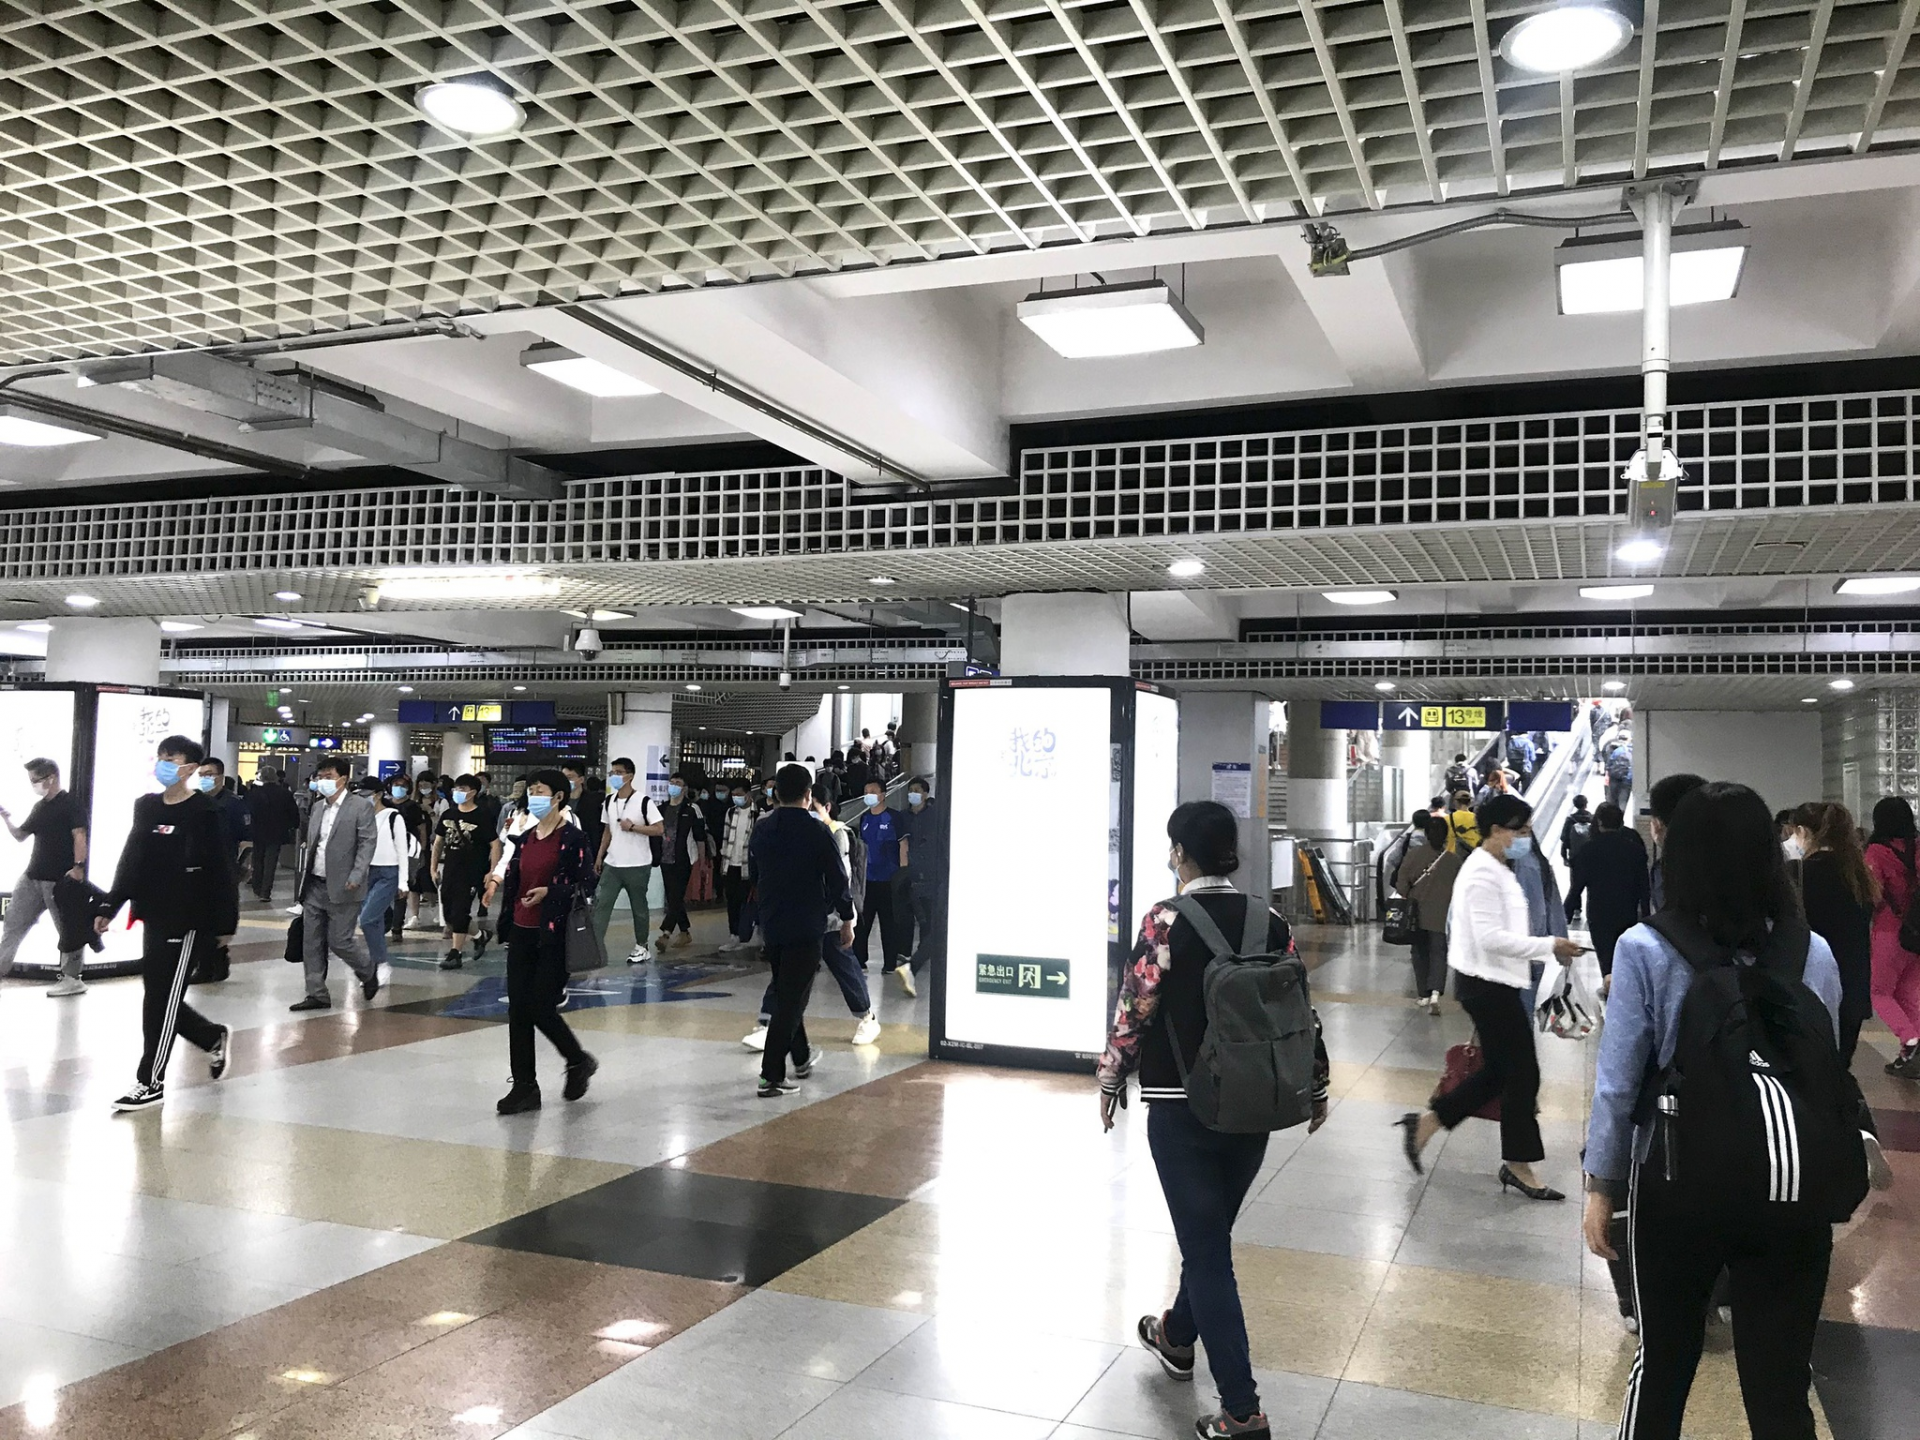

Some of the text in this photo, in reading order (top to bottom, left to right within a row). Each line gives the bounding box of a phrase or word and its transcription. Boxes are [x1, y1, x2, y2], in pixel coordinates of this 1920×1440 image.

[1009, 727, 1057, 753] 我的
[978, 963, 1014, 977] 紧急出口
